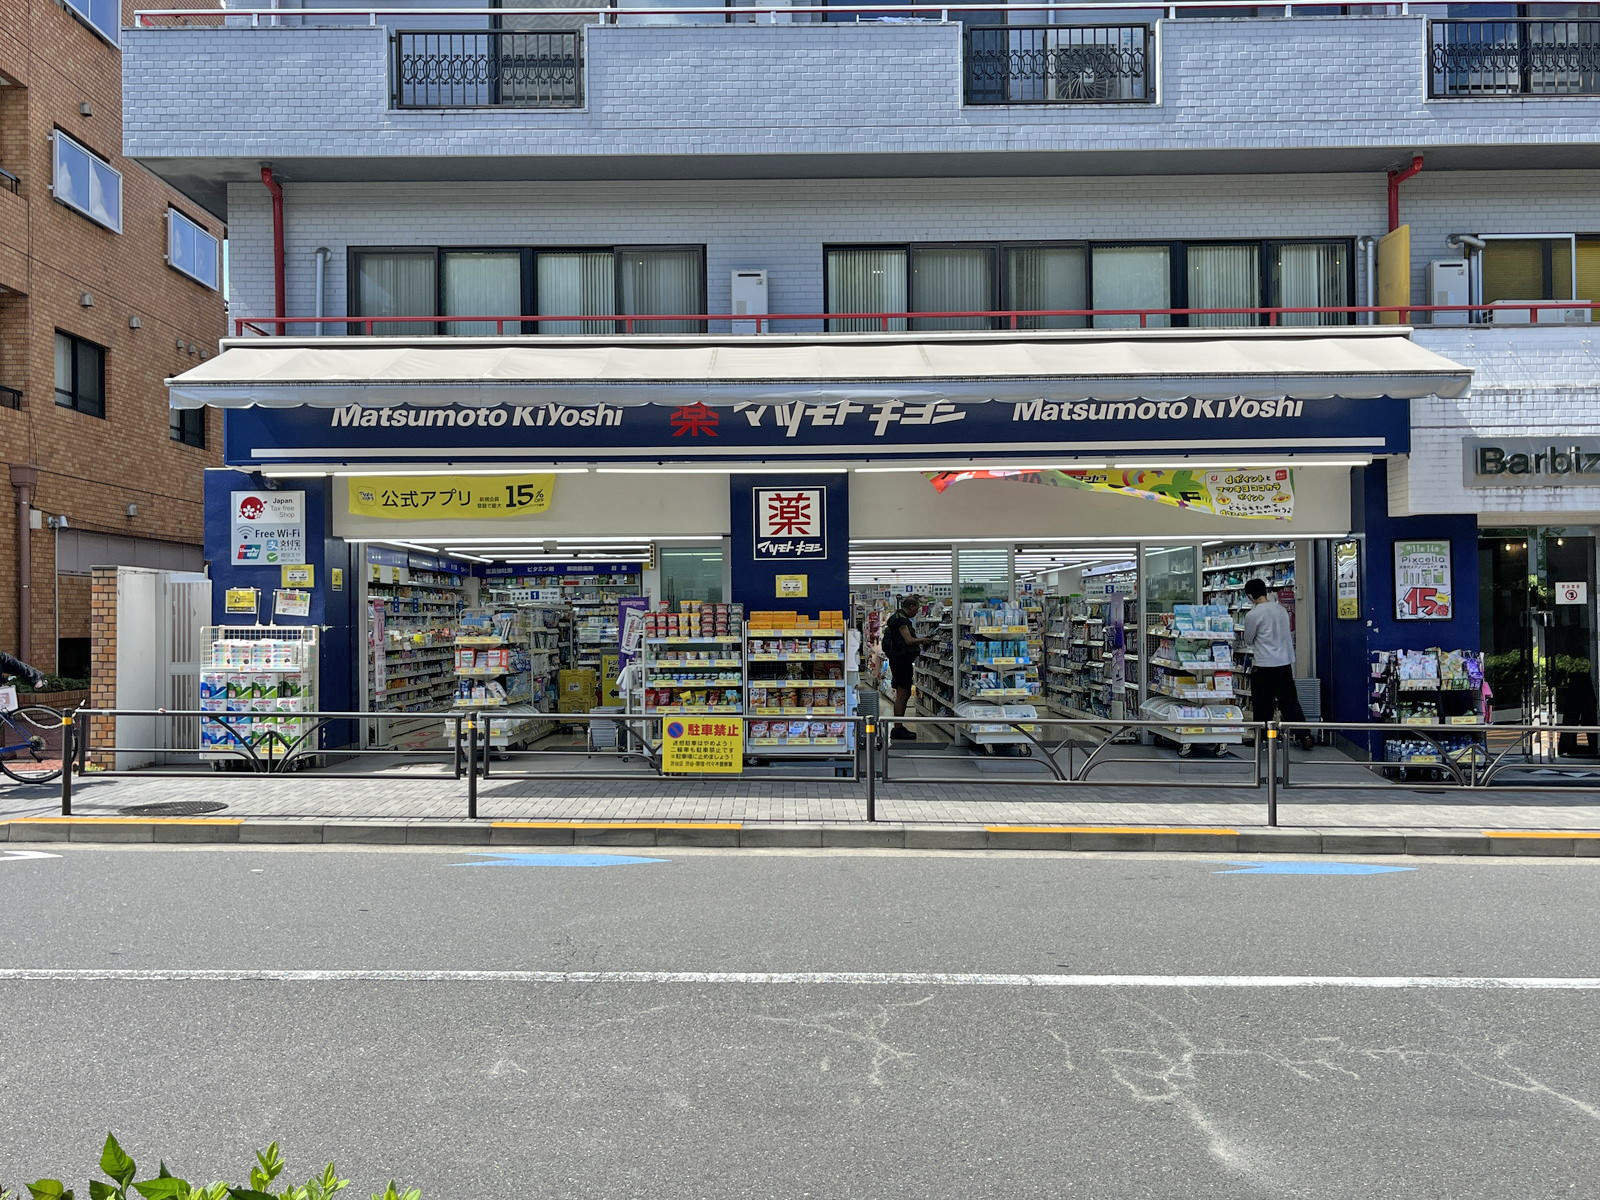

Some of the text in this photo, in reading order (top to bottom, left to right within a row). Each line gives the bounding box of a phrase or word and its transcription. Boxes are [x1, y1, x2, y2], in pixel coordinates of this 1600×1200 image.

[331, 403, 624, 427] Matsumoto KiYoshi
[1012, 396, 1304, 421] Matsumoto KiYoshi
[1216, 482, 1281, 493] マツキヨココカラ
[381, 488, 471, 508] 公式アプリ
[1238, 493, 1265, 501] ポイント
[768, 493, 811, 535] 薬
[255, 529, 300, 538] Free Wi-Fi
[687, 723, 739, 736] 駐車禁止
